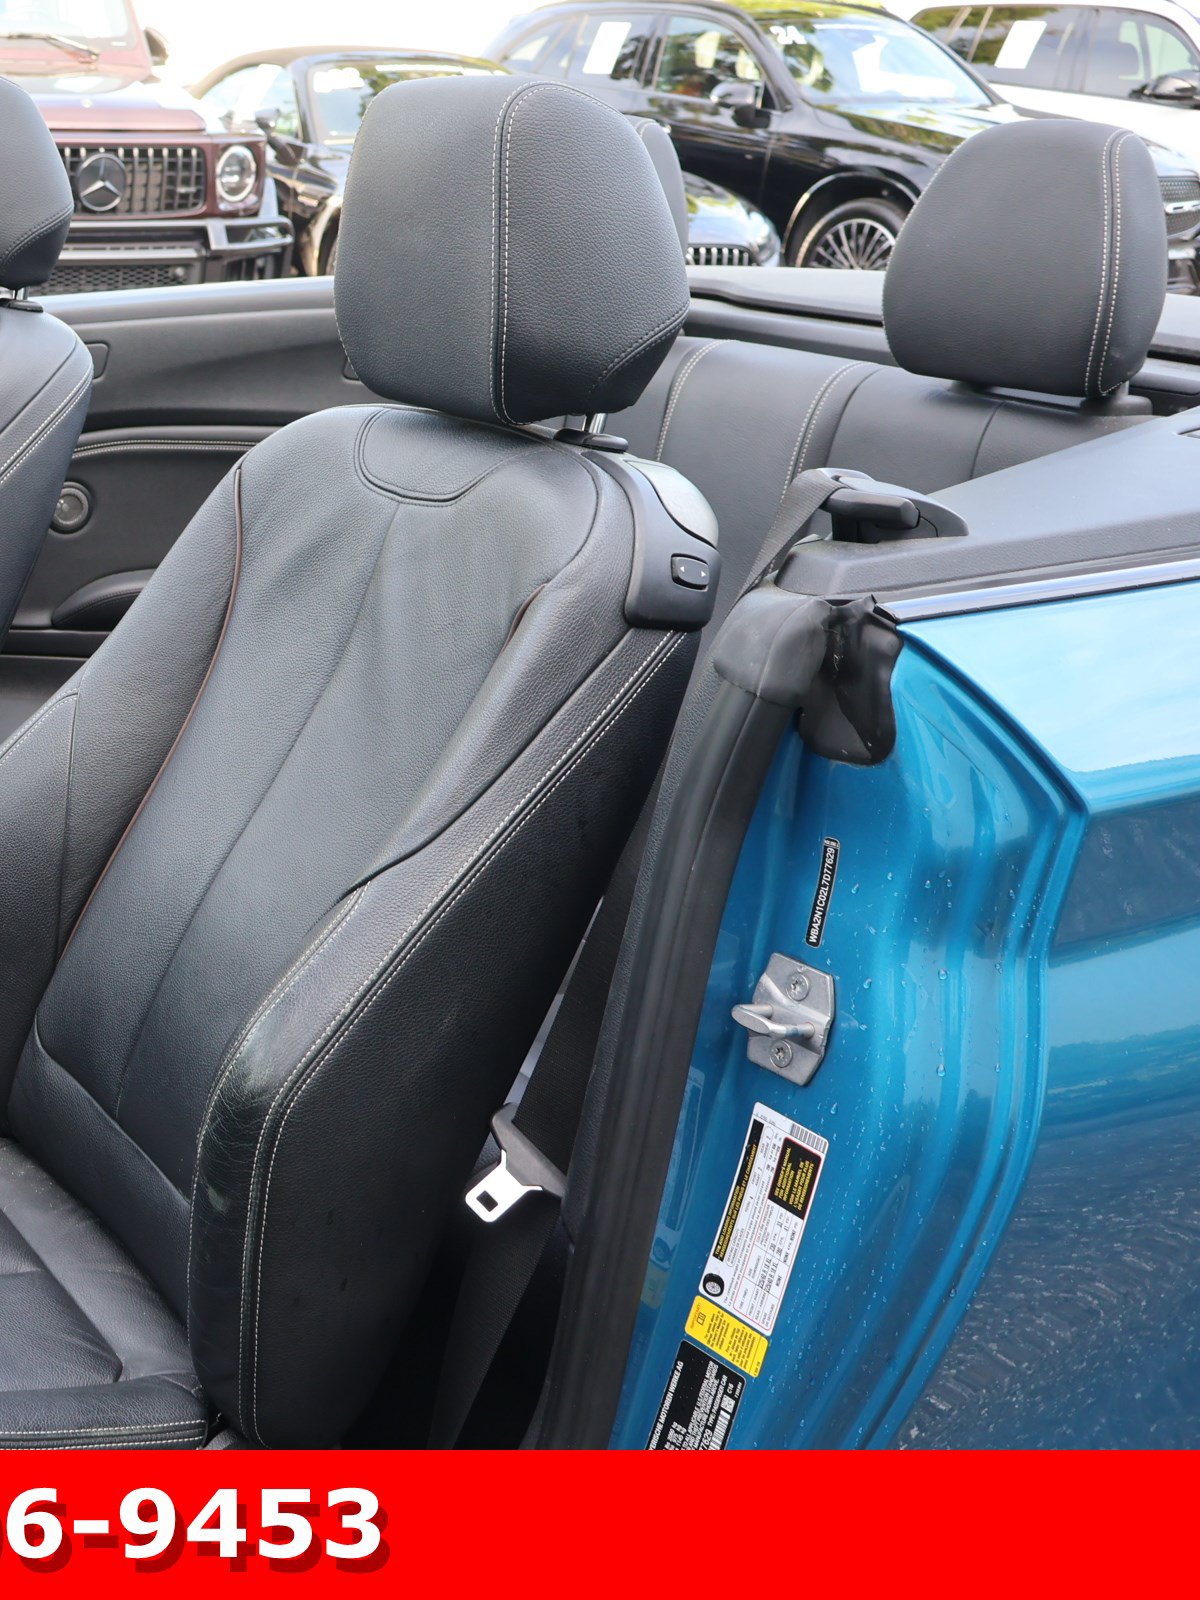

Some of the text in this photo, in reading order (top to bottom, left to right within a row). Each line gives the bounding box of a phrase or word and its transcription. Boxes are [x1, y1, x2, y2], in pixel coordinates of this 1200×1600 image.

[809, 846, 835, 943] WBA2N1C02L7D77629
[658, 1391, 673, 1423] MOTOREN
[668, 1369, 680, 1393] WERKE
[675, 1360, 683, 1371] AG
[711, 1384, 724, 1413] PASSENGER
[720, 1374, 728, 1386] CAR
